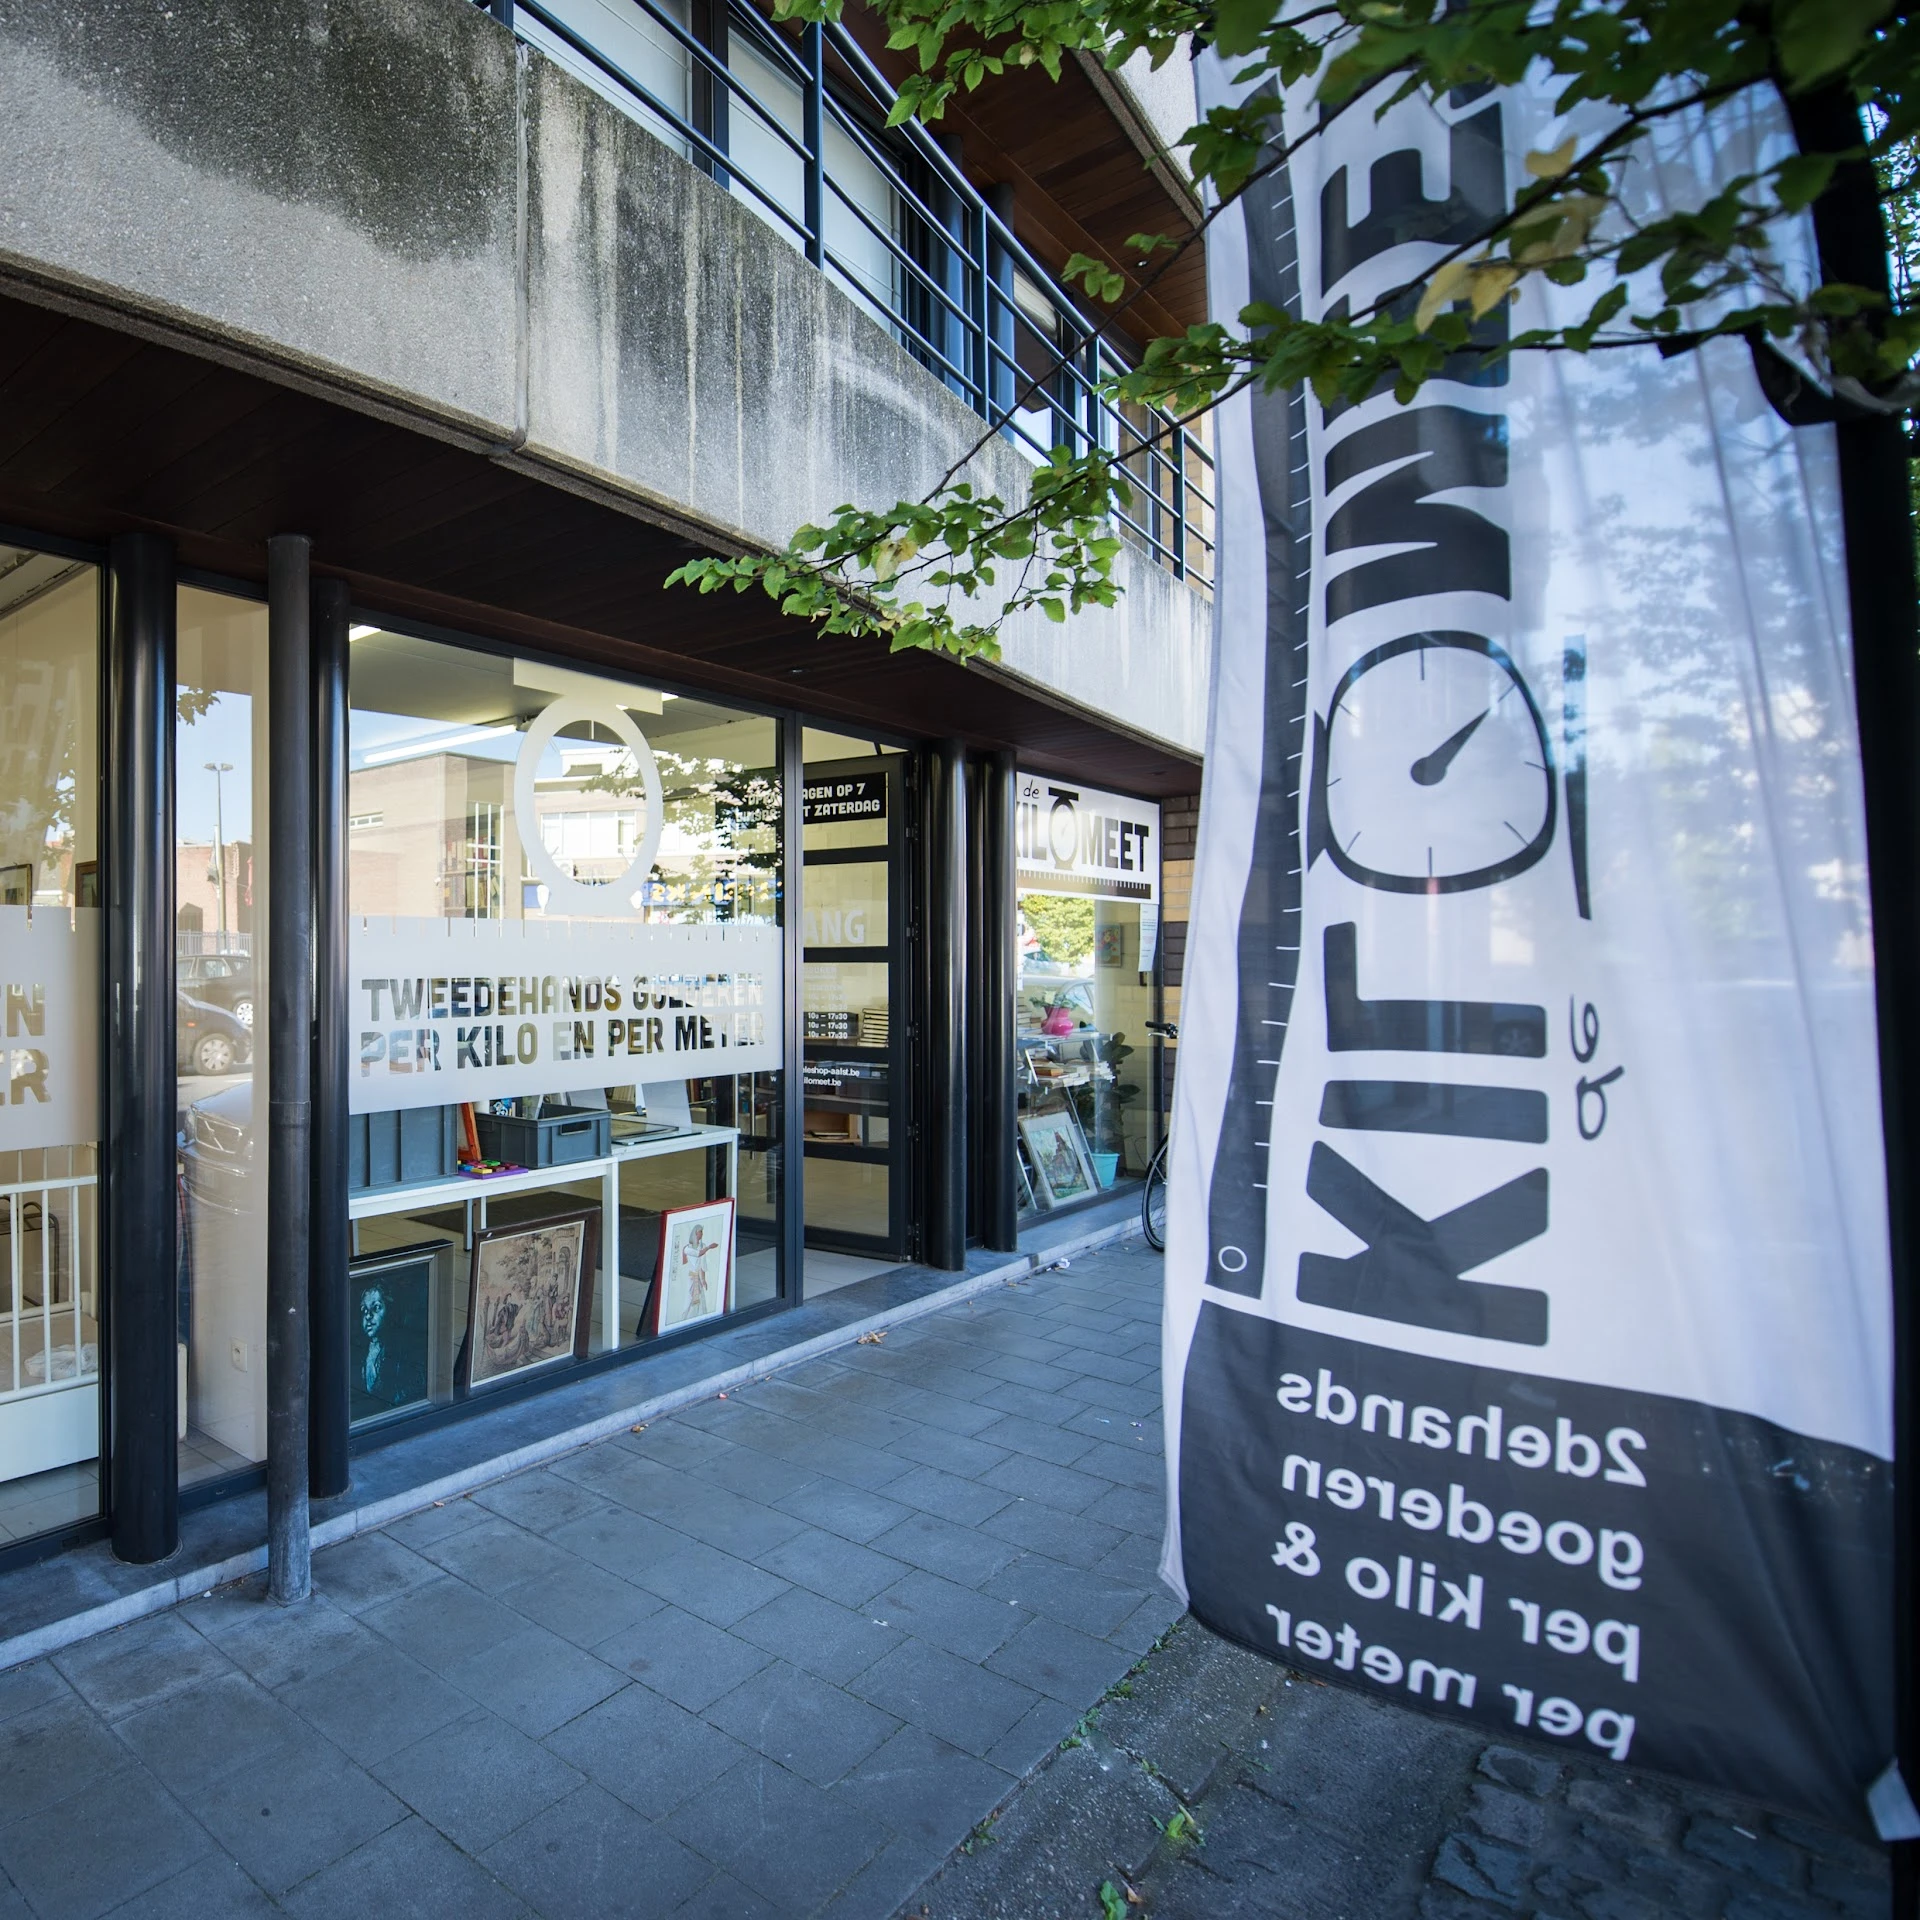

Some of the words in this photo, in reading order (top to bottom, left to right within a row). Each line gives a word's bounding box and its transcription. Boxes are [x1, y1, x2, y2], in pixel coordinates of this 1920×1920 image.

[837, 784, 853, 797] OP
[856, 782, 866, 795] 7
[1023, 779, 1040, 799] de
[814, 799, 880, 816] ZATERDAG
[361, 974, 622, 1022] TWEEDEHANDS
[361, 1028, 442, 1077] PER
[457, 1022, 538, 1069] KILO
[553, 1021, 594, 1061] EN
[608, 1017, 664, 1056] PER
[675, 1012, 764, 1051] METER
